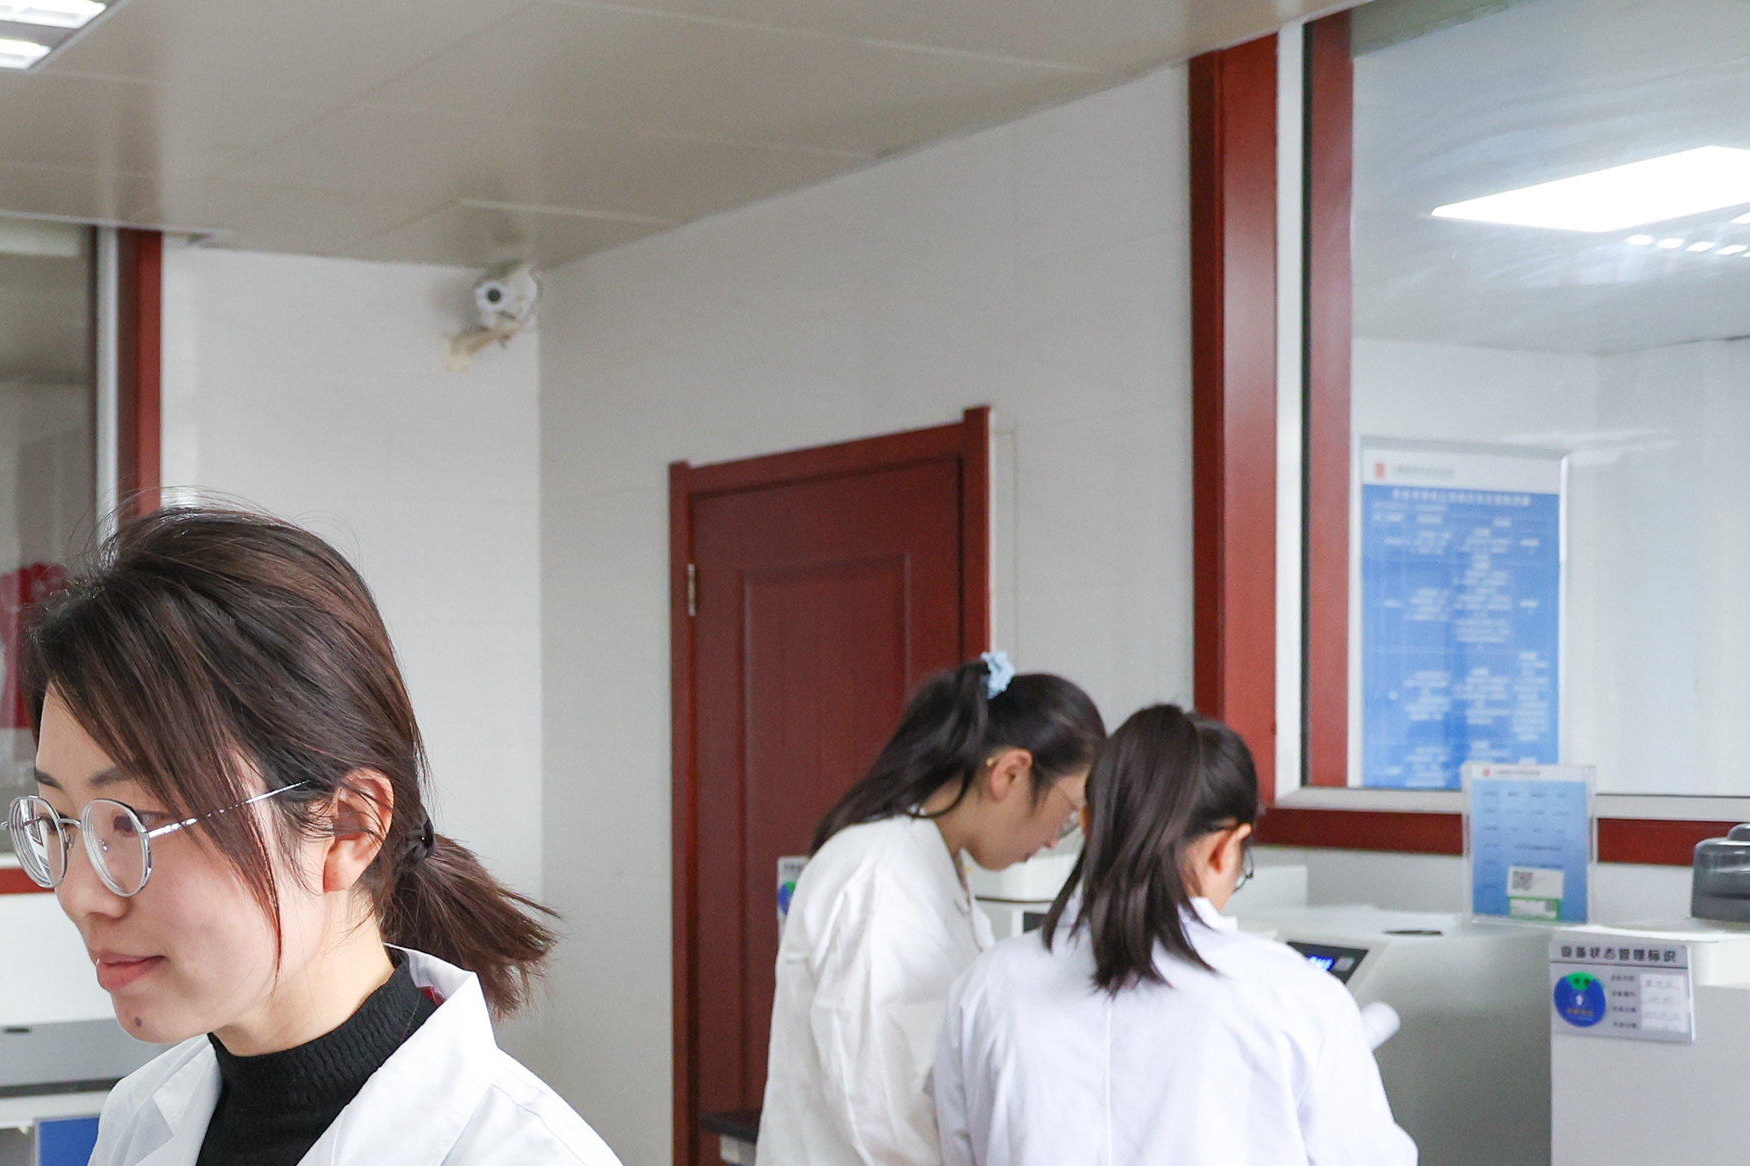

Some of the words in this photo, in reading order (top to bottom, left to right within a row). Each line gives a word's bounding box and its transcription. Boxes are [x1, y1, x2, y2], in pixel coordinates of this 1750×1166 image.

[1561, 946, 1676, 962] 设备状态管理标识
